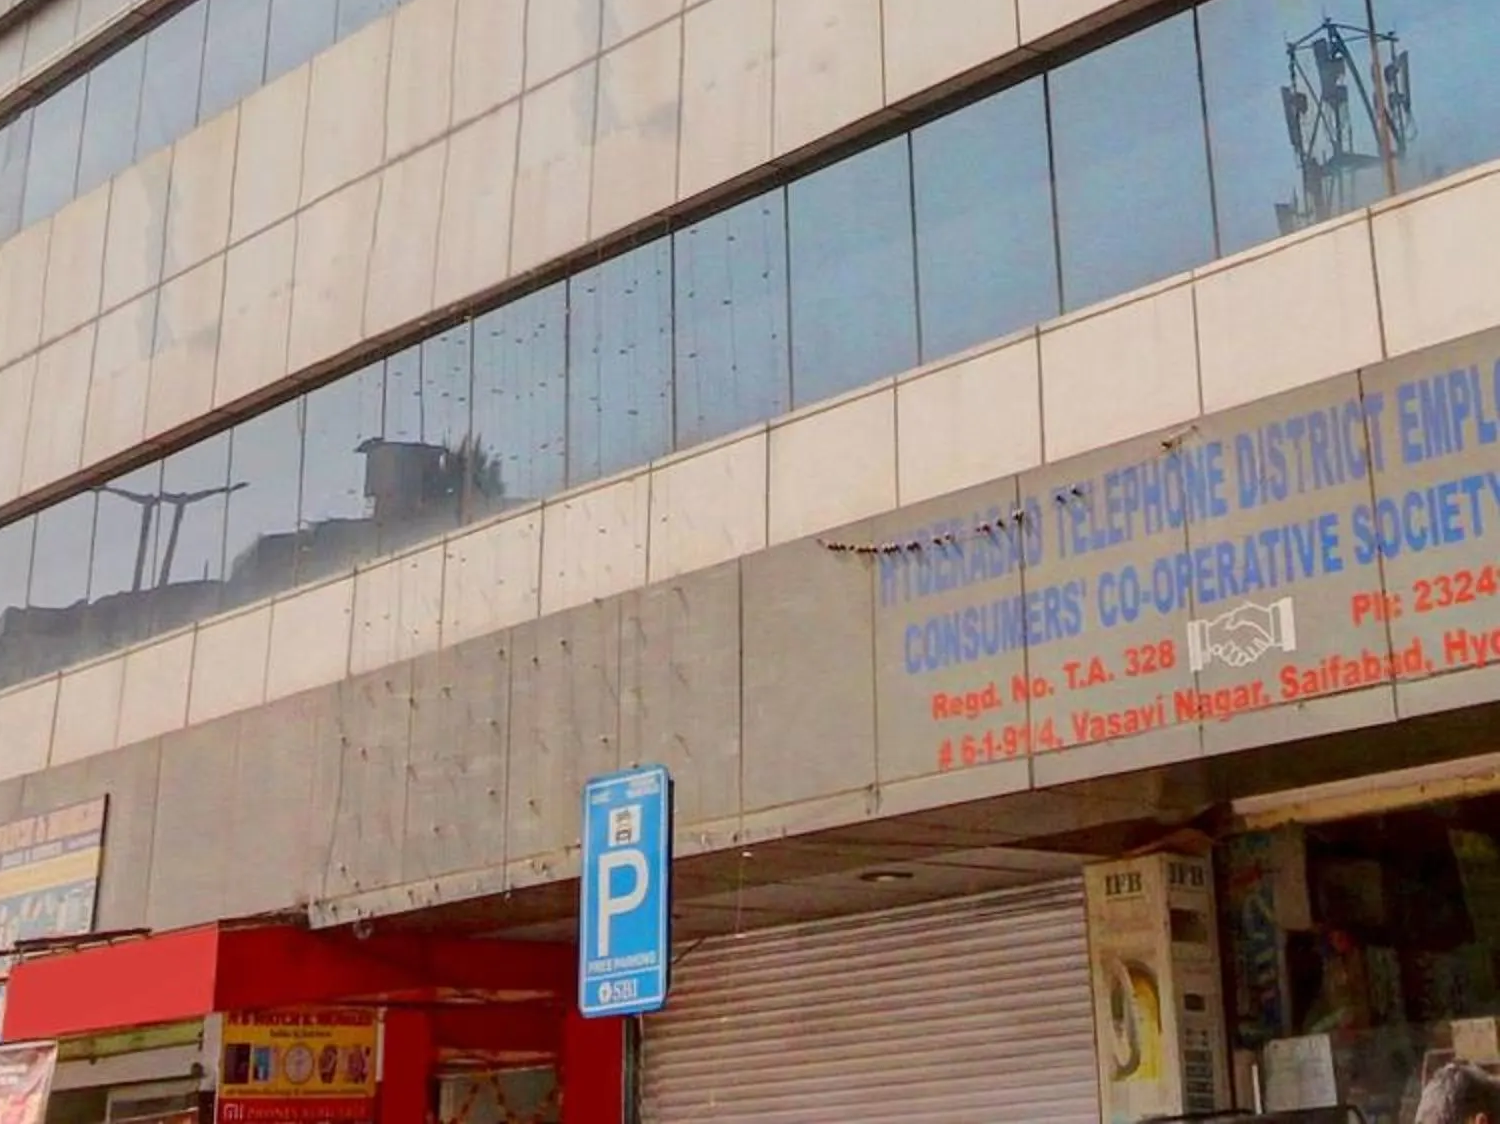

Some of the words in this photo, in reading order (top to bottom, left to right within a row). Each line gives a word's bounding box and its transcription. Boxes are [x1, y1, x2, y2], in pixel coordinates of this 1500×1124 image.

[1053, 441, 1228, 560] TELEPHONE
[1233, 391, 1385, 510] DISTRICT
[1396, 357, 1500, 466] EMPL
[1098, 511, 1344, 628] CO-OPERATIVE
[1412, 564, 1500, 614] 2324
[931, 682, 1003, 721] Regd.
[1011, 675, 1055, 702] No.
[1063, 655, 1114, 690] T.A.
[1124, 639, 1177, 676] 328
[1071, 696, 1166, 742] Vasavi
[597, 848, 649, 958] P
[1105, 871, 1142, 896] IFB
[1168, 861, 1204, 887] IFB
